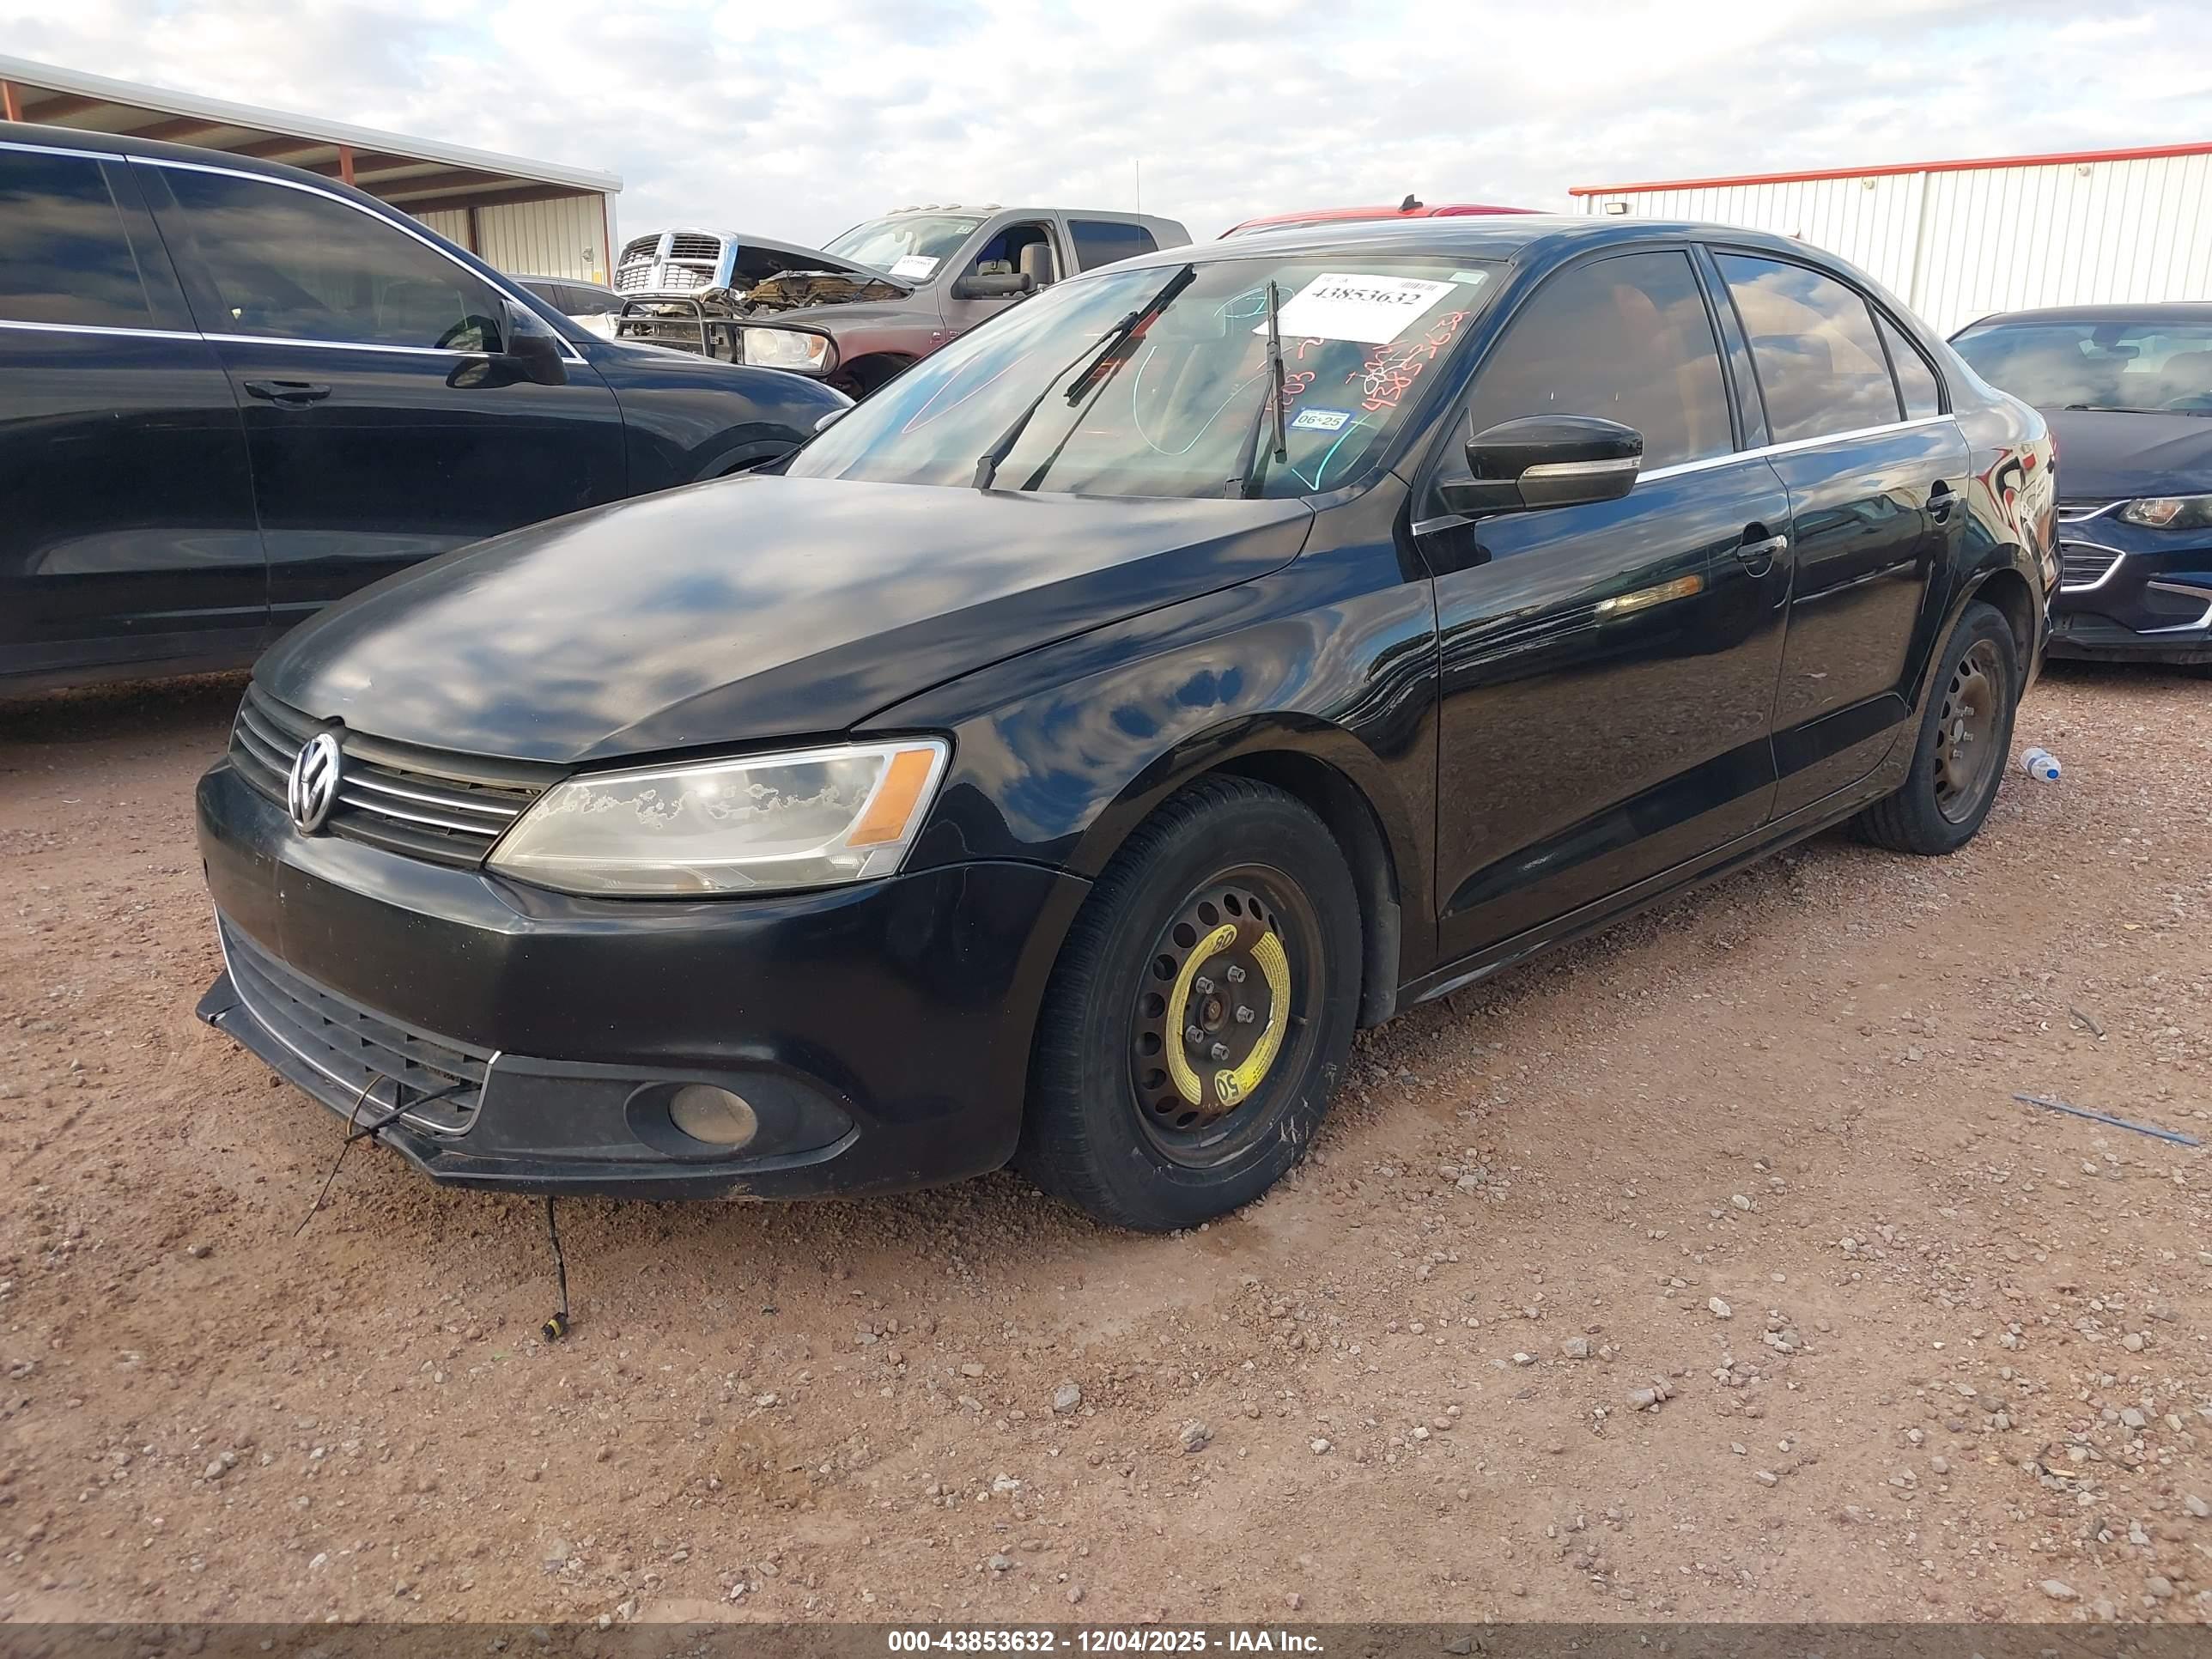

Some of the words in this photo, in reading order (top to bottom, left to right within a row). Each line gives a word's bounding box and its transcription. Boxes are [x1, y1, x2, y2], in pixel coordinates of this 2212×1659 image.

[1311, 286, 1422, 305] 43853632
[1211, 930, 1235, 953] 80
[1216, 1073, 1239, 1101] 50
